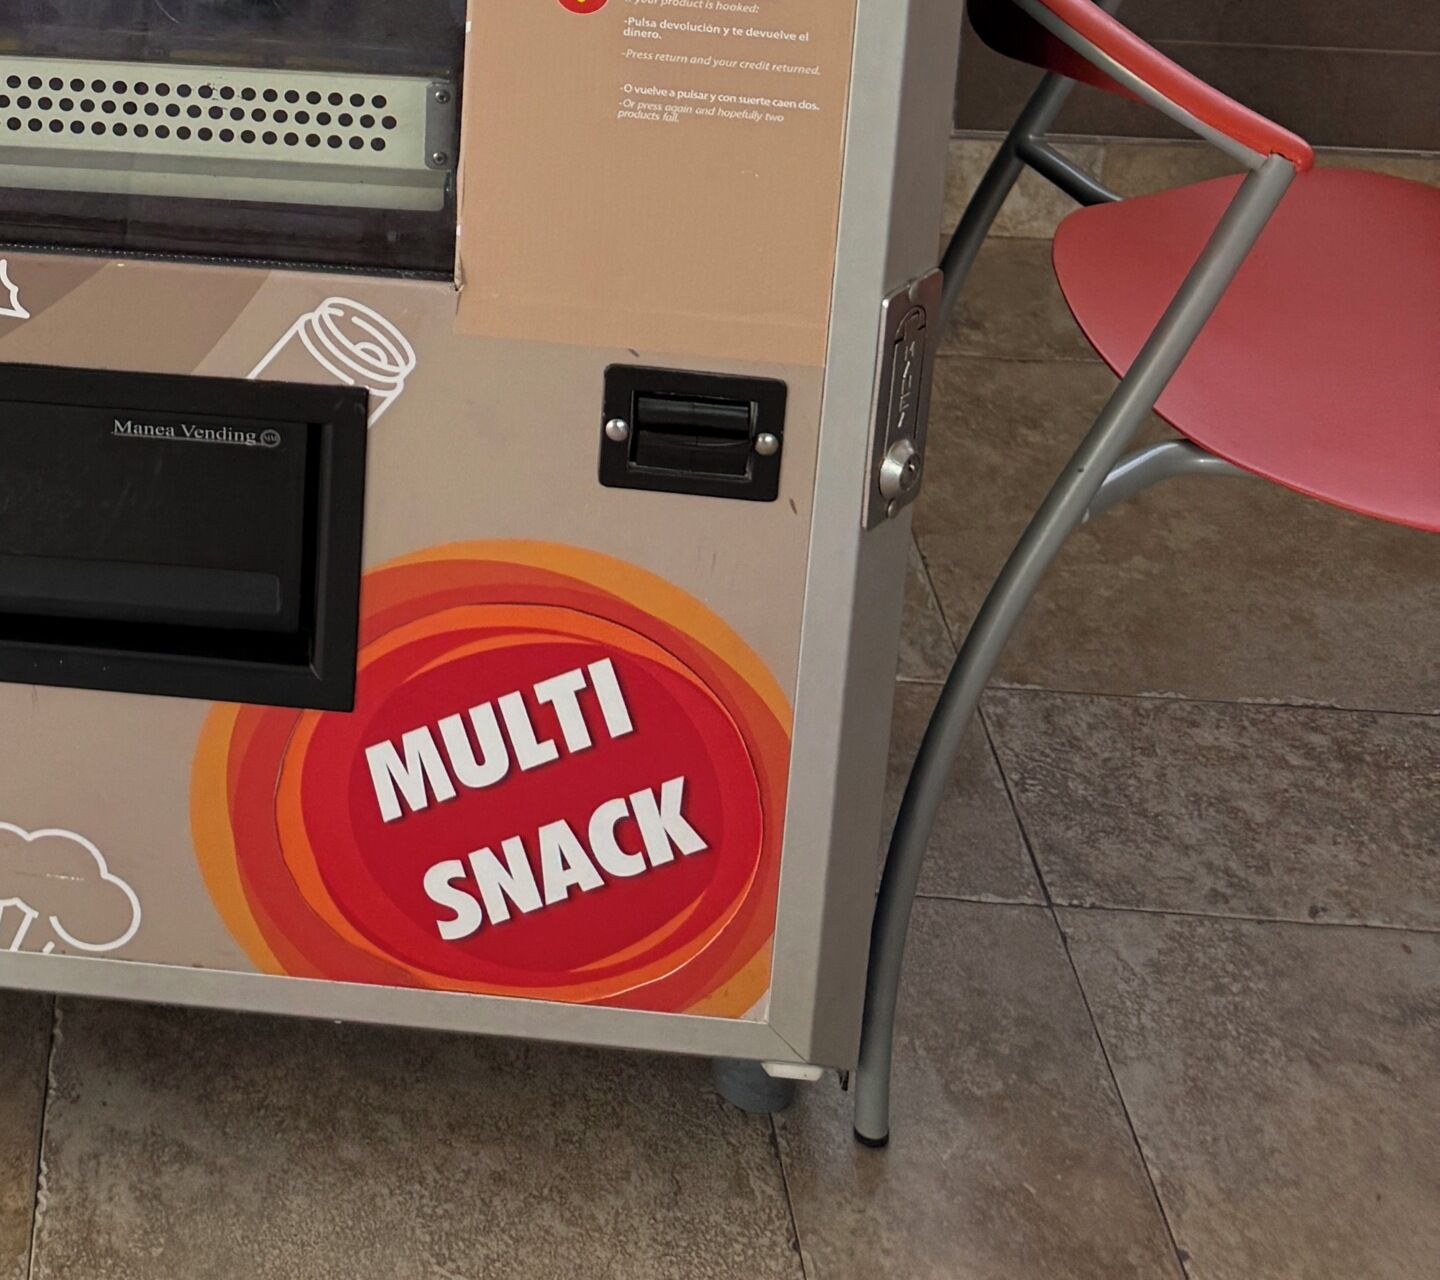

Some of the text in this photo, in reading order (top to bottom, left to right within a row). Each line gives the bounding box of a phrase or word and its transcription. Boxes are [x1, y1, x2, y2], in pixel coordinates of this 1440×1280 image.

[660, 19, 796, 41] devolución devuelve
[655, 52, 770, 72] return credit
[634, 85, 770, 106] vuelve pulsar suerte
[717, 107, 763, 123] hopefully
[181, 424, 256, 446] Vending
[365, 657, 633, 823] MULTI
[423, 776, 708, 940] SNACK
